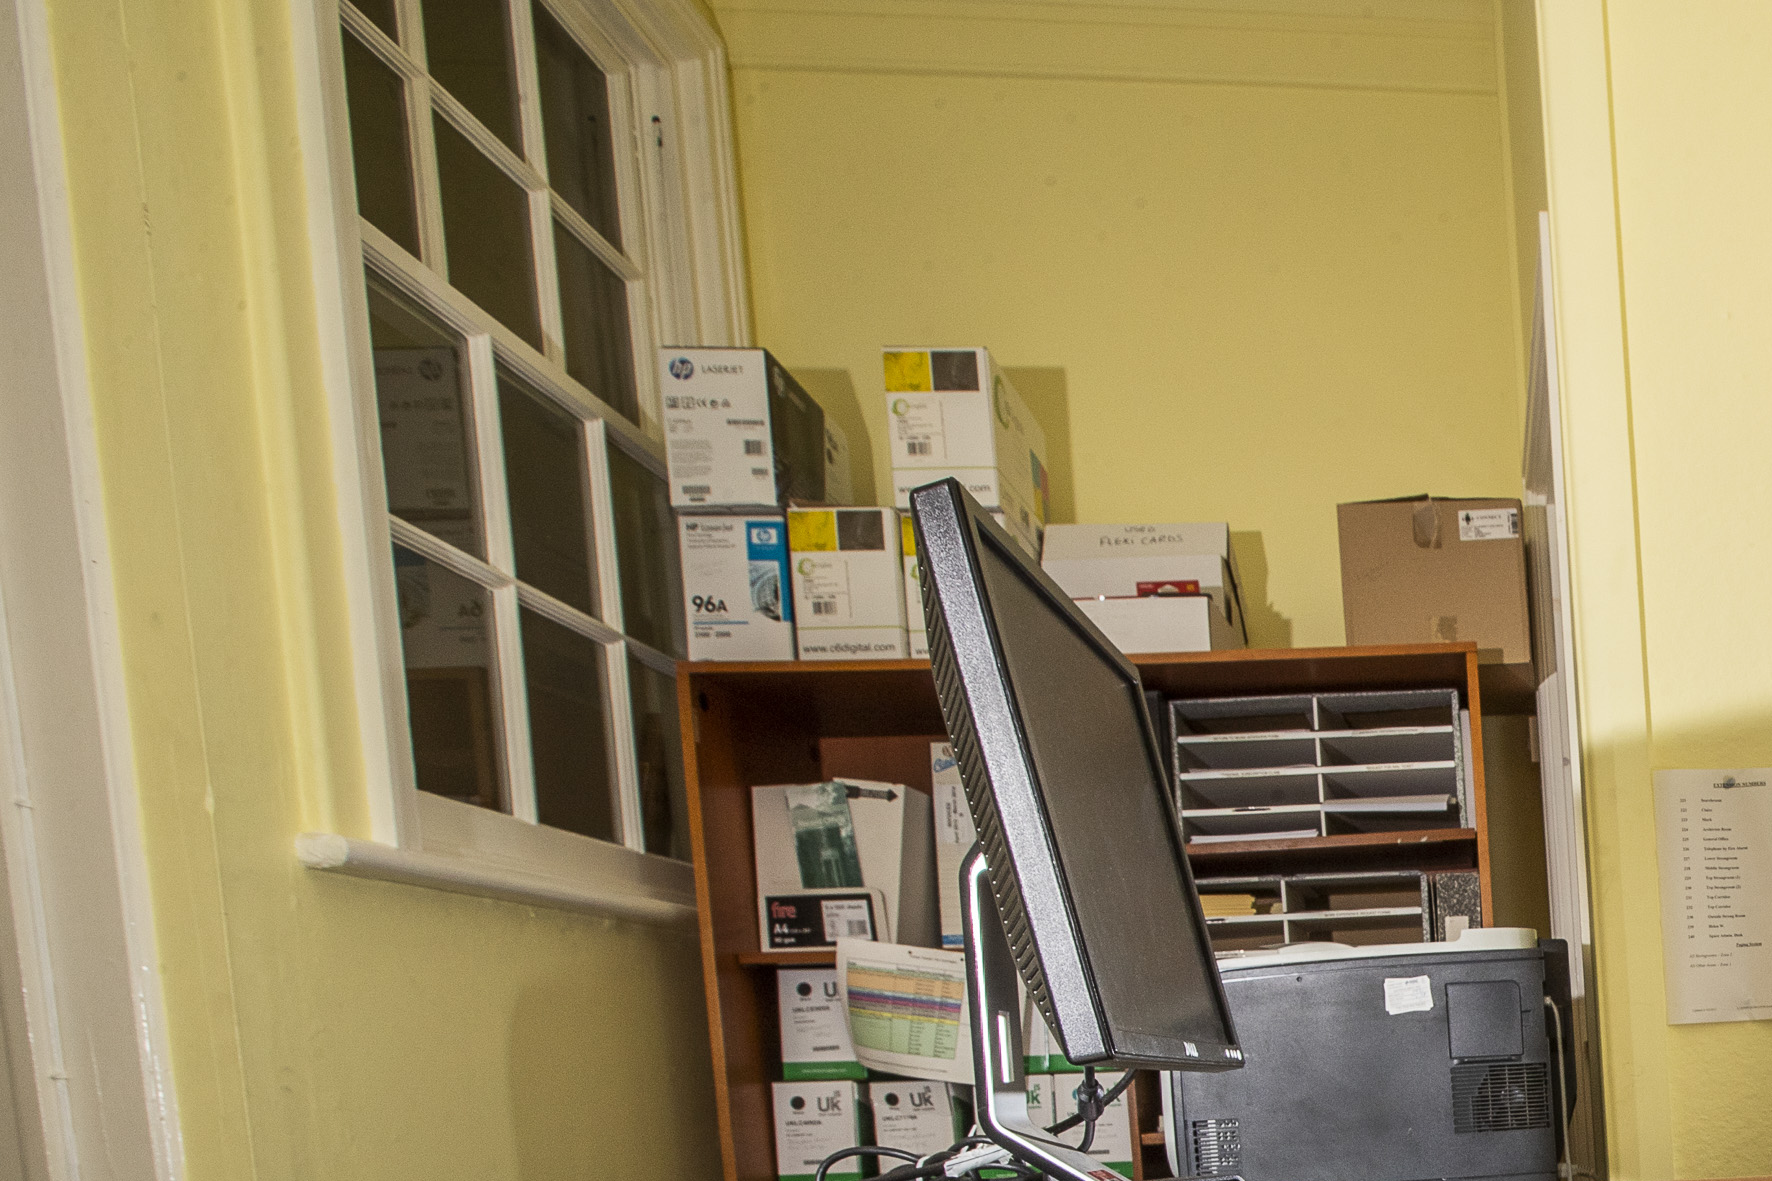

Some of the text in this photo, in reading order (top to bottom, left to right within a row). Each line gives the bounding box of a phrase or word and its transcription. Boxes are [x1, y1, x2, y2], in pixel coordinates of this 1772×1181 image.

[701, 364, 744, 374] LASERJET
[1141, 534, 1183, 545] CARDS
[692, 595, 728, 613] 96A
[771, 901, 797, 919] fire
[774, 923, 789, 935] A4
[823, 981, 837, 997] U
